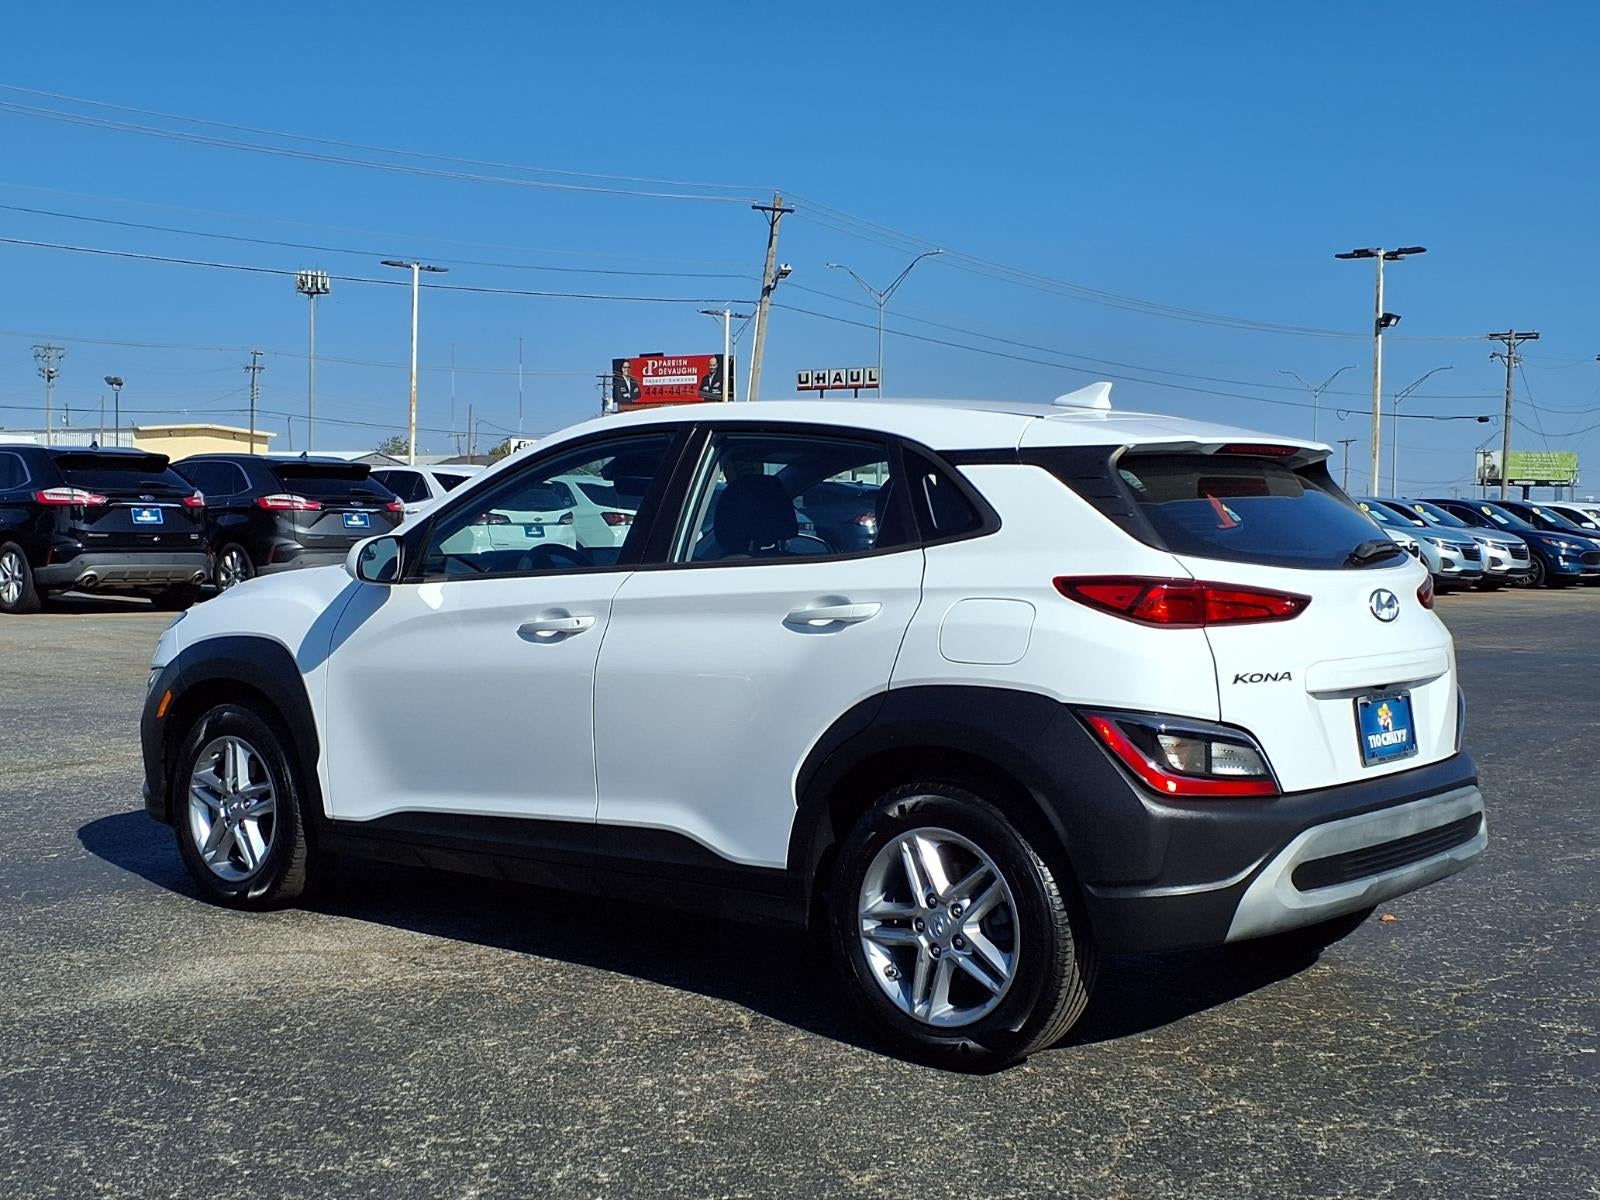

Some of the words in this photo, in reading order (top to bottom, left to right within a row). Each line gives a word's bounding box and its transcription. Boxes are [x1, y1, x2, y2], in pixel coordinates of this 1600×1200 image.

[658, 359, 688, 367] PARRISH
[658, 367, 697, 375] DEVAUGHN
[798, 370, 877, 384] UHAUL
[1232, 671, 1292, 685] KONA
